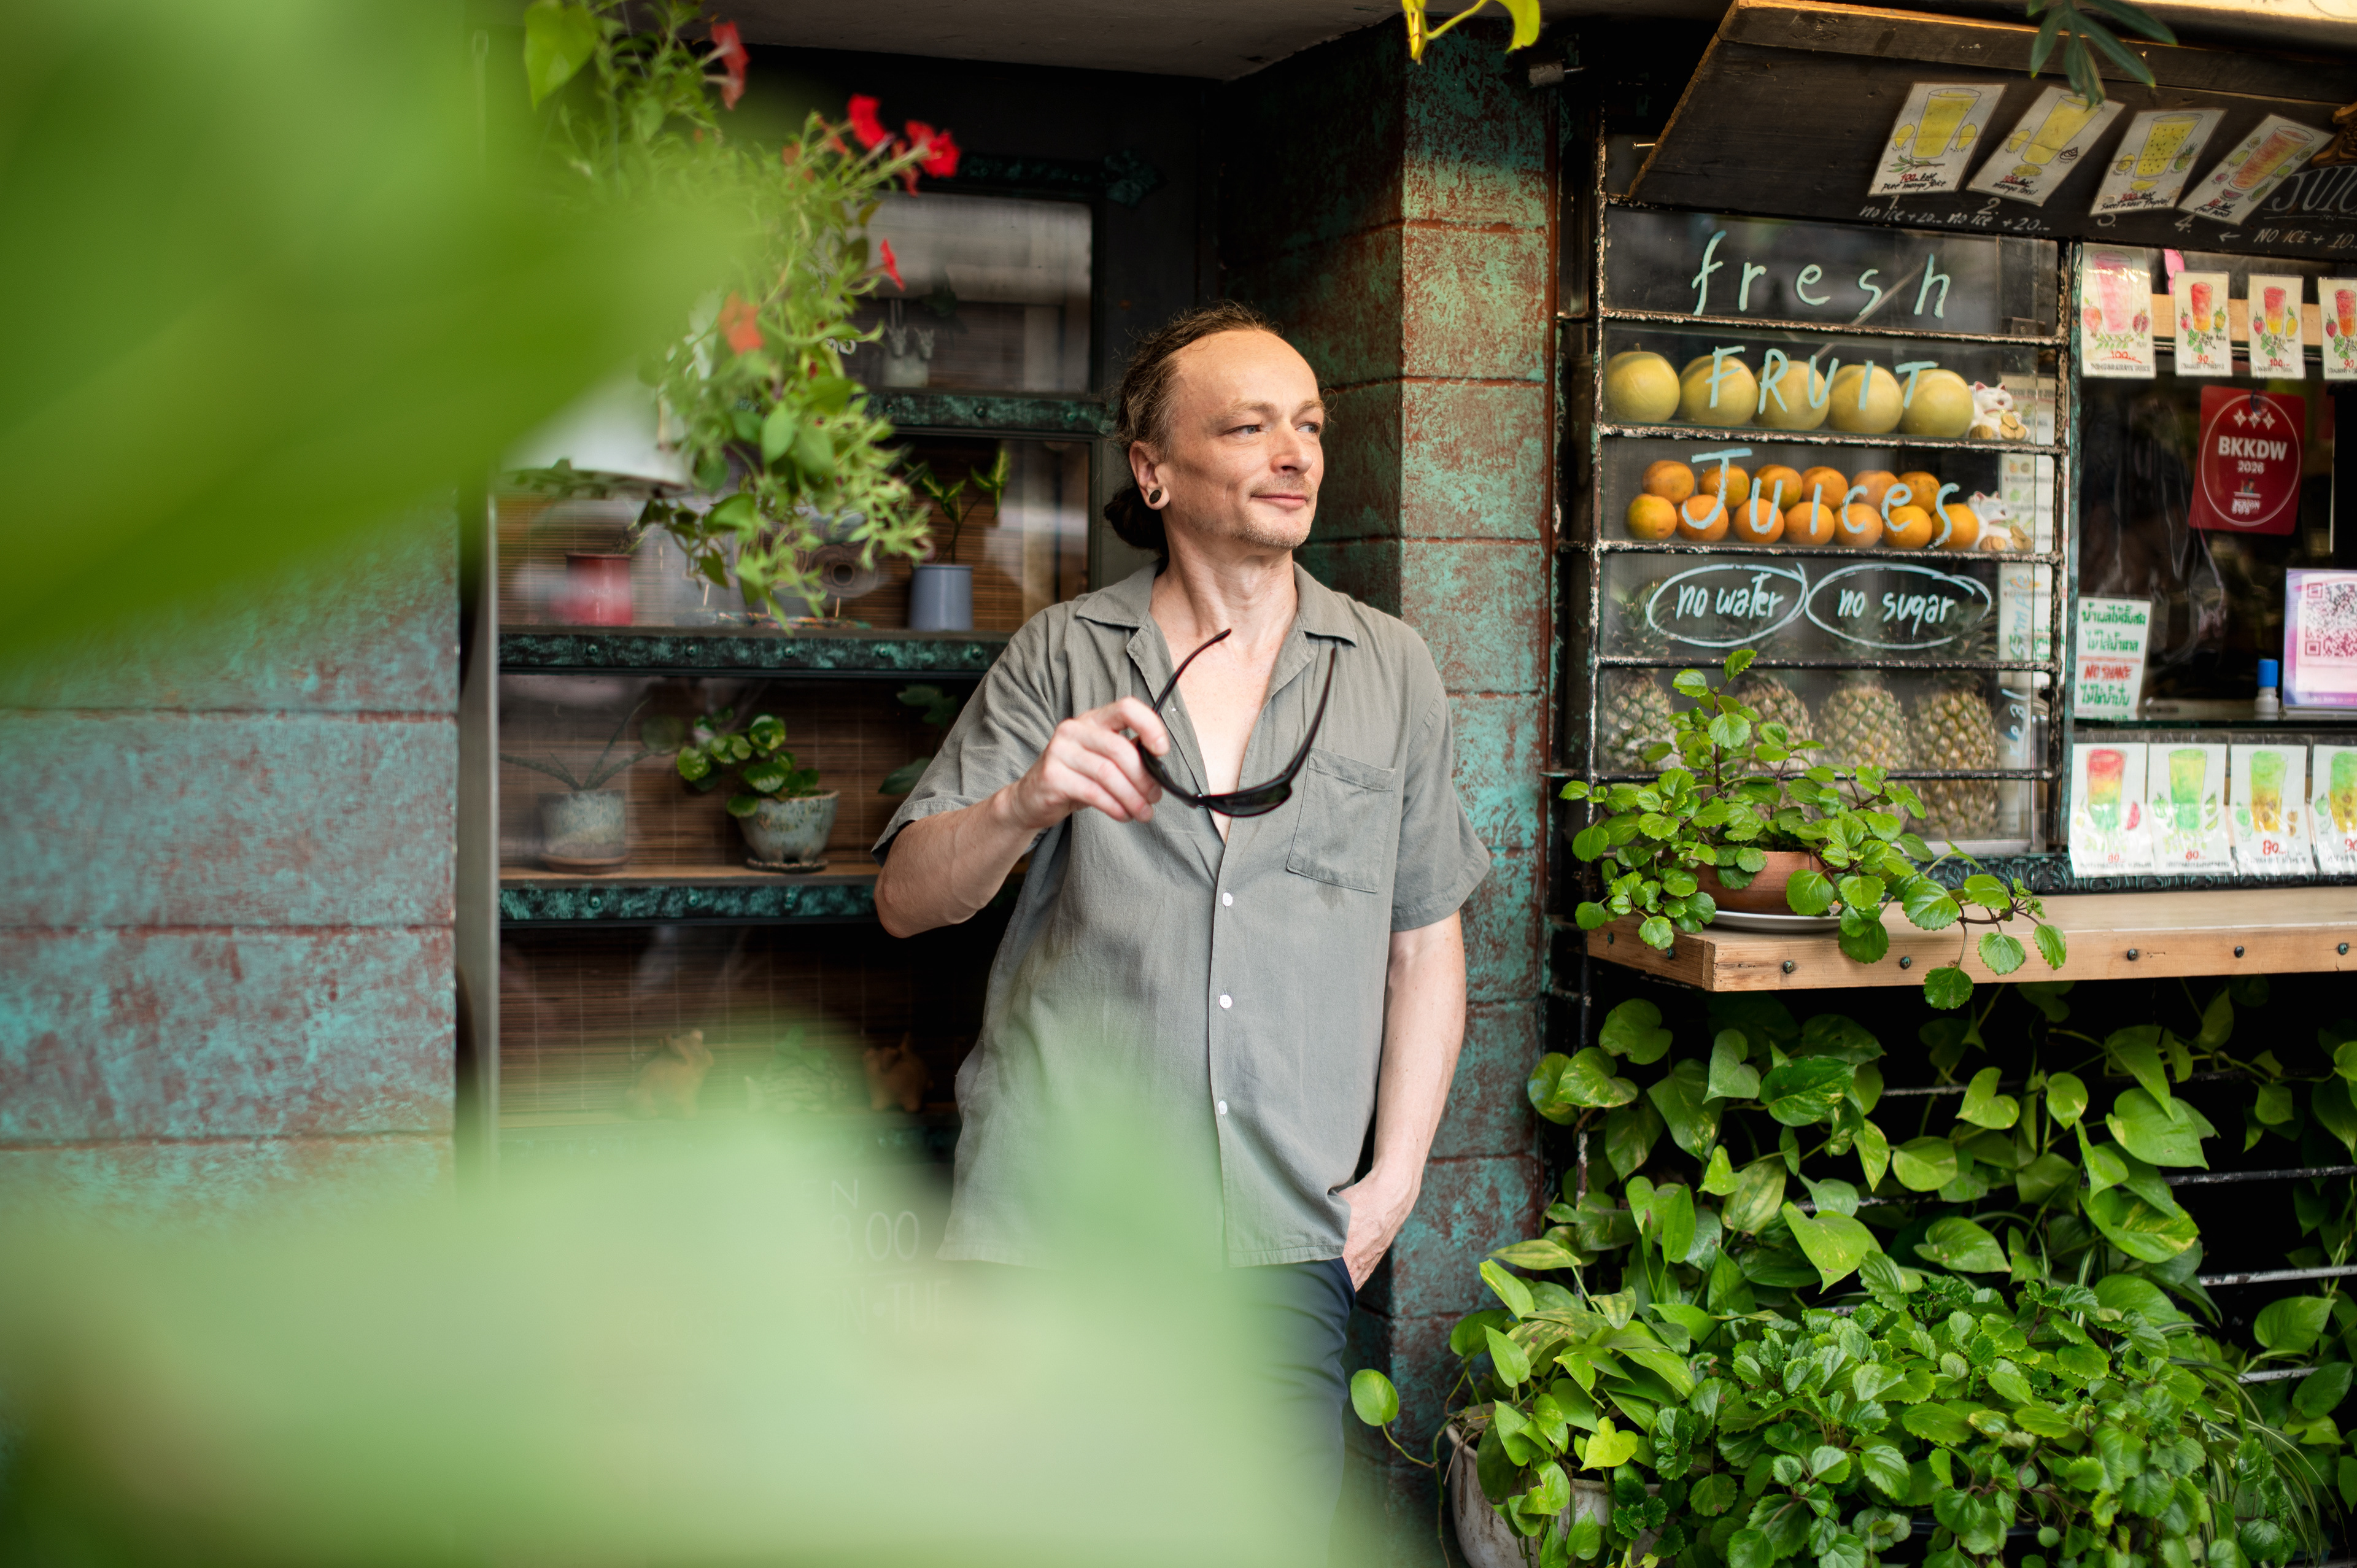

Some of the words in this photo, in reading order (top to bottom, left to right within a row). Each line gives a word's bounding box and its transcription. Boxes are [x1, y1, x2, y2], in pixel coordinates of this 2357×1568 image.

[1976, 196, 2002, 215] 2.
[2253, 227, 2280, 244] NO
[2283, 229, 2312, 244] ICE
[1691, 230, 1951, 319] fresh
[1705, 345, 1940, 415] FRUIT
[2218, 434, 2288, 462] BKKDW
[2237, 460, 2265, 475] 2026
[1676, 584, 1708, 621] no
[1715, 572, 1784, 620] water
[1837, 588, 1865, 618] no
[1882, 592, 1956, 640] sugar
[2083, 663, 2100, 680] NO
[2102, 663, 2133, 682] SHAKE
